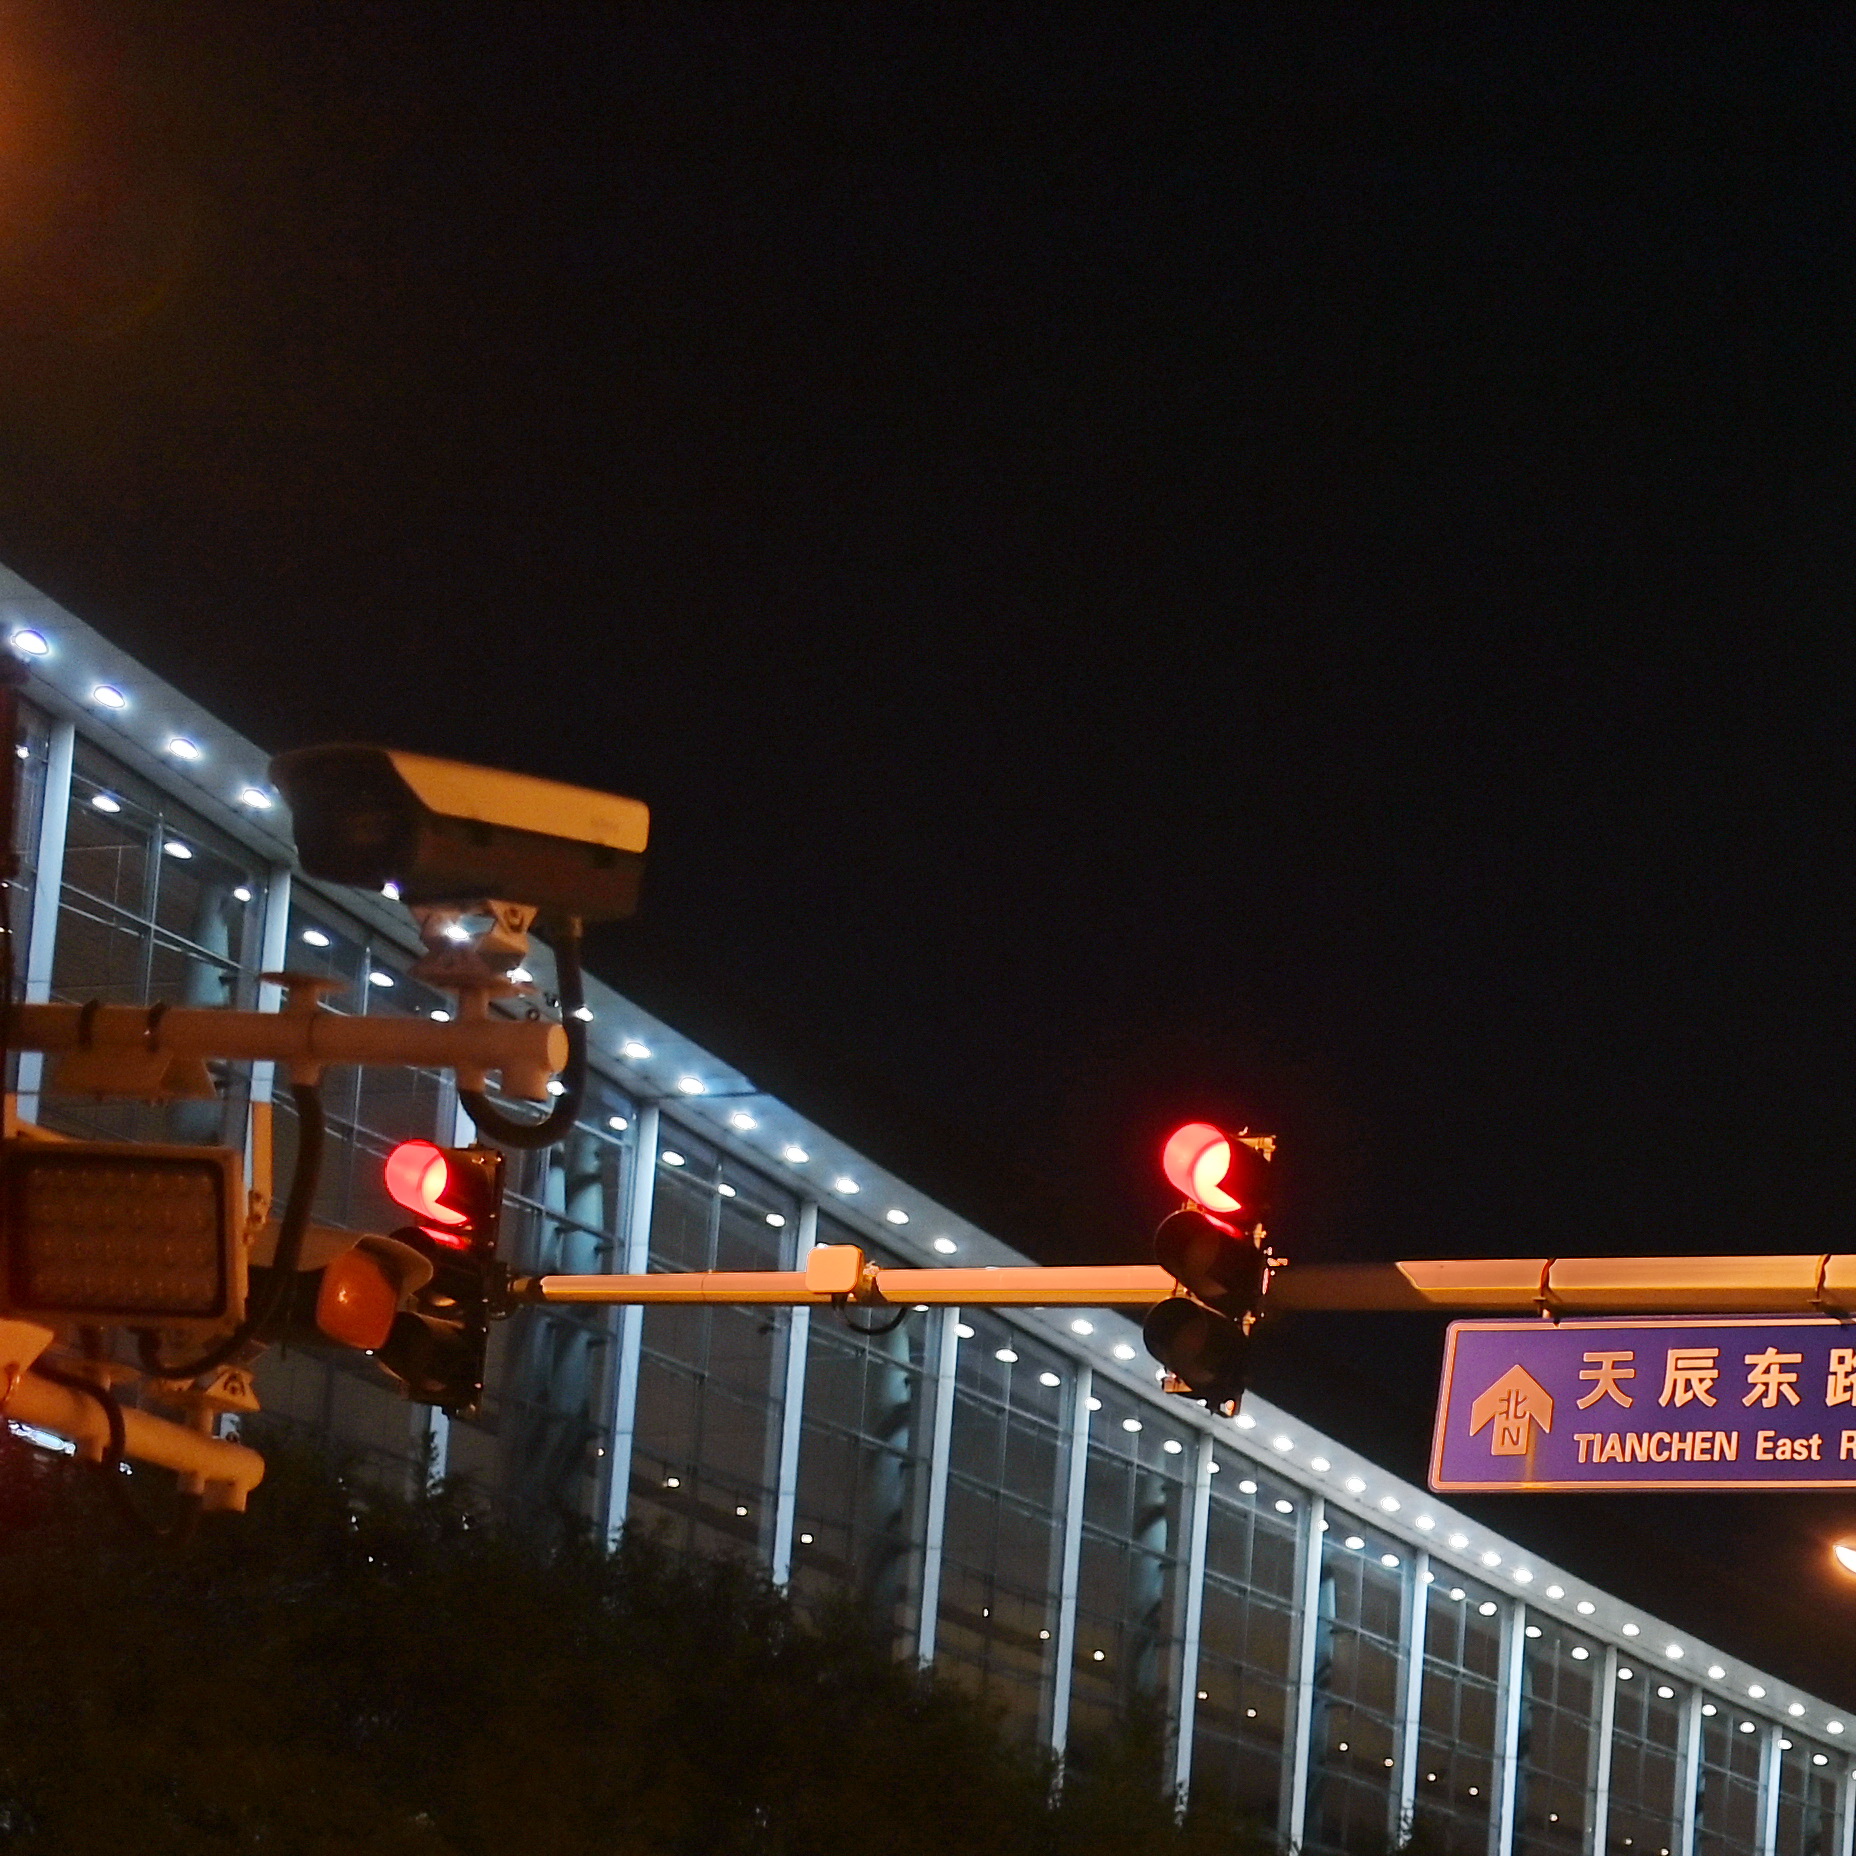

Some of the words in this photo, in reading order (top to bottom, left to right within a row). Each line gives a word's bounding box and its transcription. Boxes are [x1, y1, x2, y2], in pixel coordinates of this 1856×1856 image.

[1499, 1389, 1527, 1420] 北
[1501, 1427, 1520, 1446] N
[1574, 1431, 1739, 1463] TIANCHEN
[1755, 1430, 1821, 1461] East
